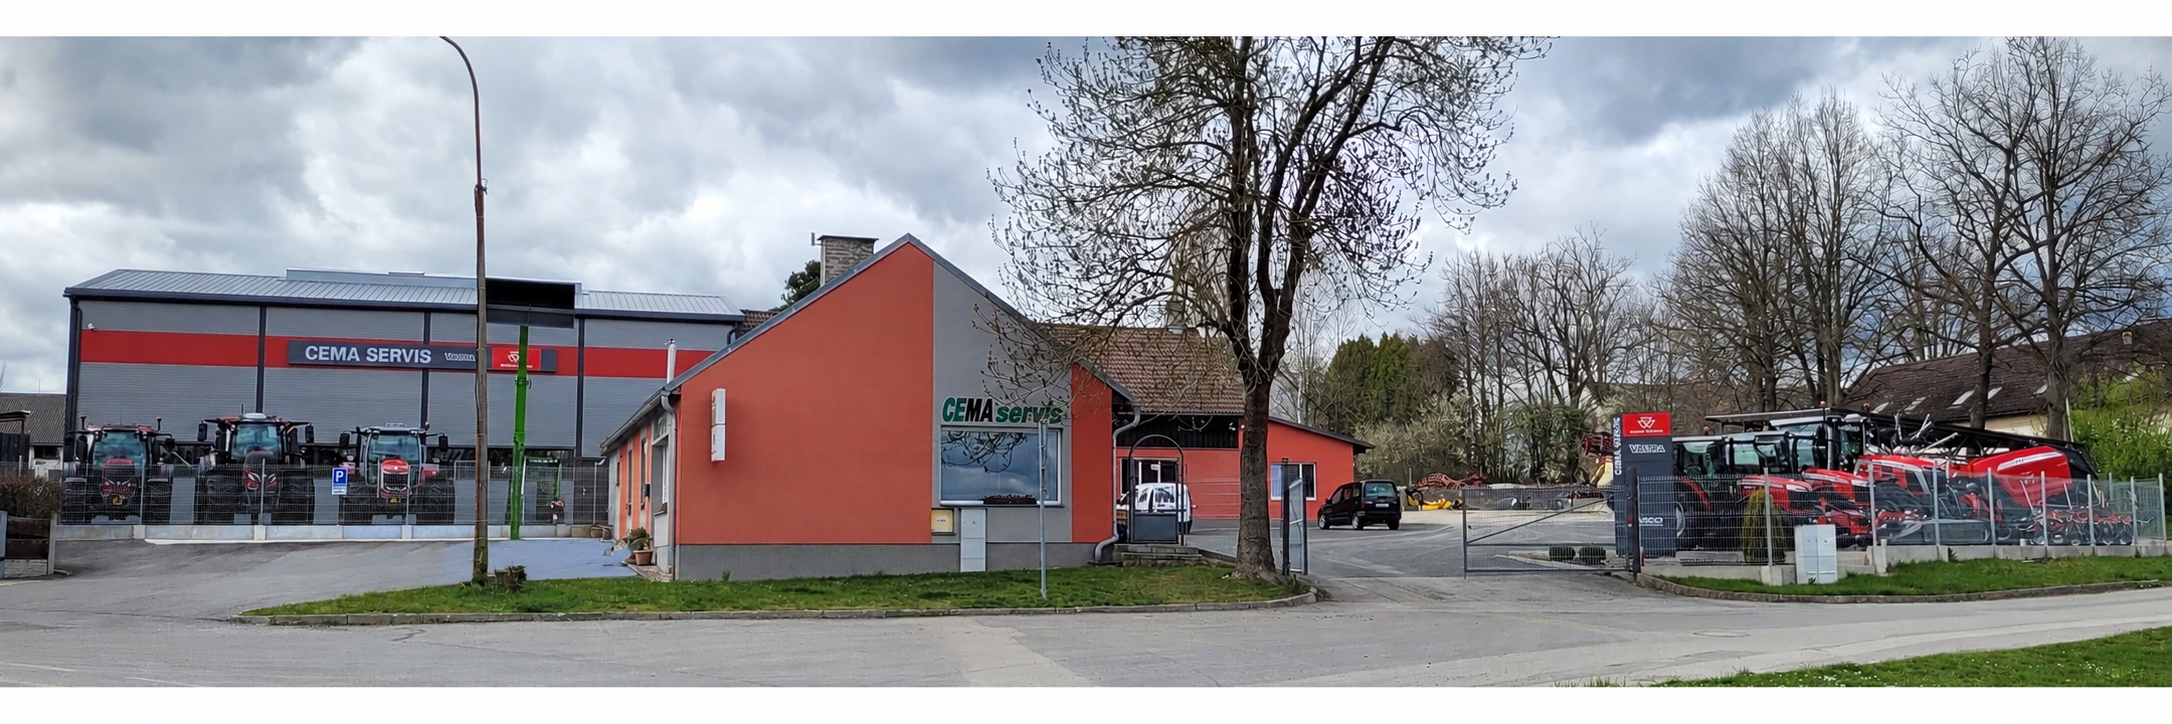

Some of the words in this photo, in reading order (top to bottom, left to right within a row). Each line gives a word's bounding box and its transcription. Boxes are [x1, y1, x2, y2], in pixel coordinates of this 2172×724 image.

[305, 345, 360, 361] CEMA
[366, 347, 432, 363] SERVIS
[942, 397, 993, 422] CEMA
[995, 405, 1063, 424] servis
[335, 470, 344, 482] P
